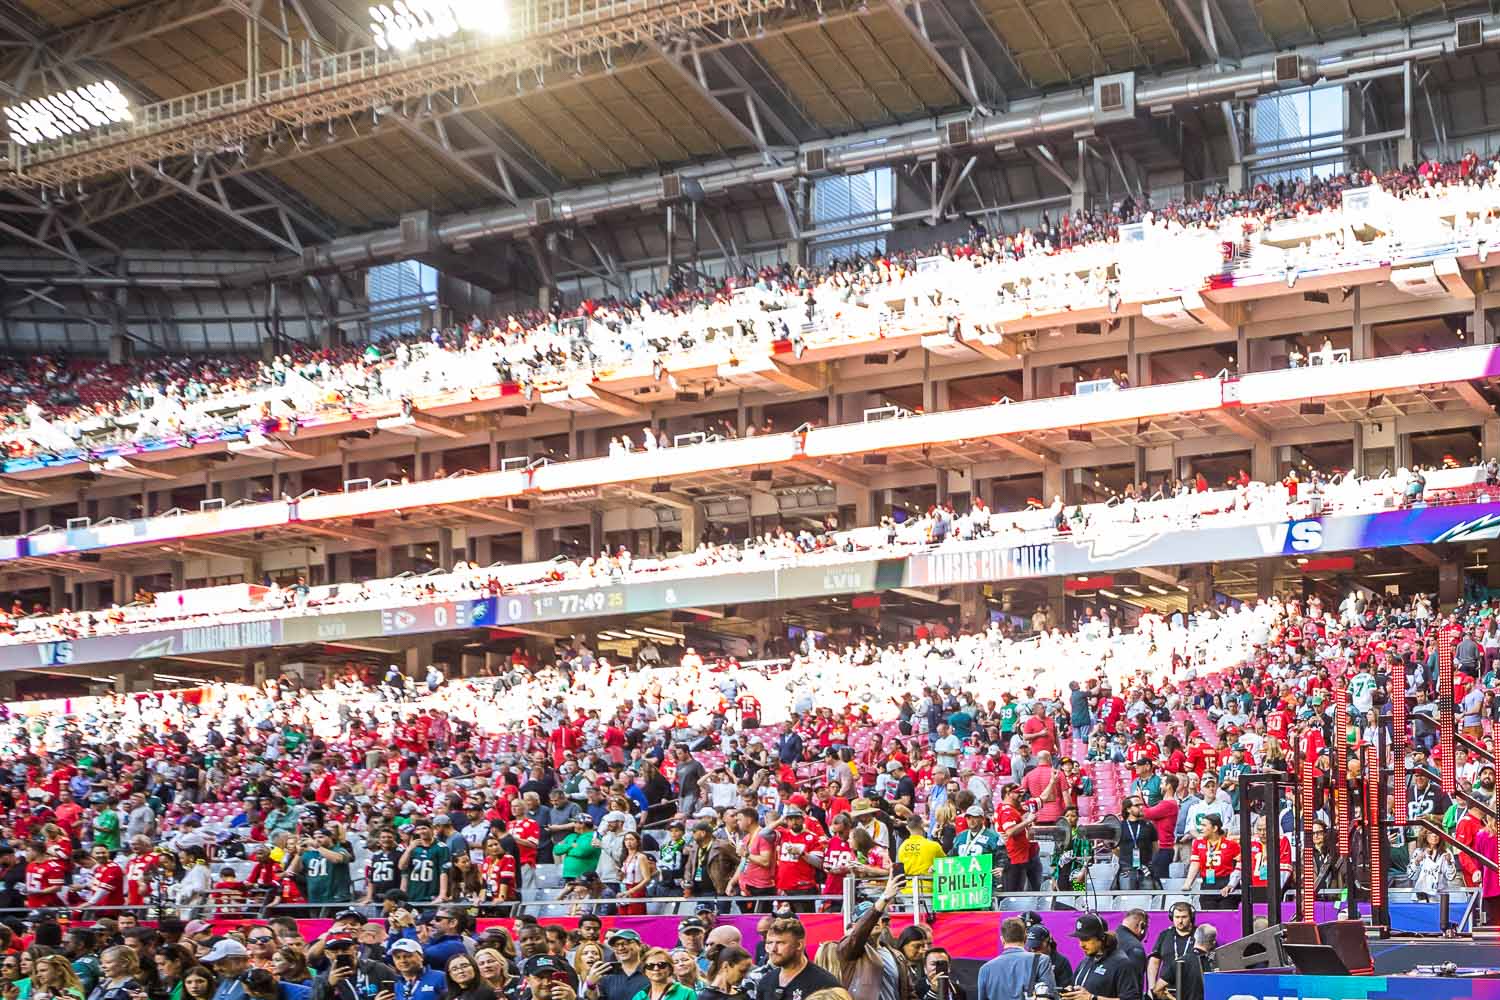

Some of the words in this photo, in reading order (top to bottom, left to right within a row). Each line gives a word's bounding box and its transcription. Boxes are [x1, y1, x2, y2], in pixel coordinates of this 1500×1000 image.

[1257, 520, 1323, 553] VS
[1012, 543, 1056, 577] CHIEFS
[38, 641, 73, 664] VS
[308, 858, 329, 878] 91
[372, 861, 394, 882] 25
[410, 859, 433, 882] 26
[969, 857, 982, 872] A
[938, 873, 987, 893] PHILLY
[938, 888, 989, 910] THING
